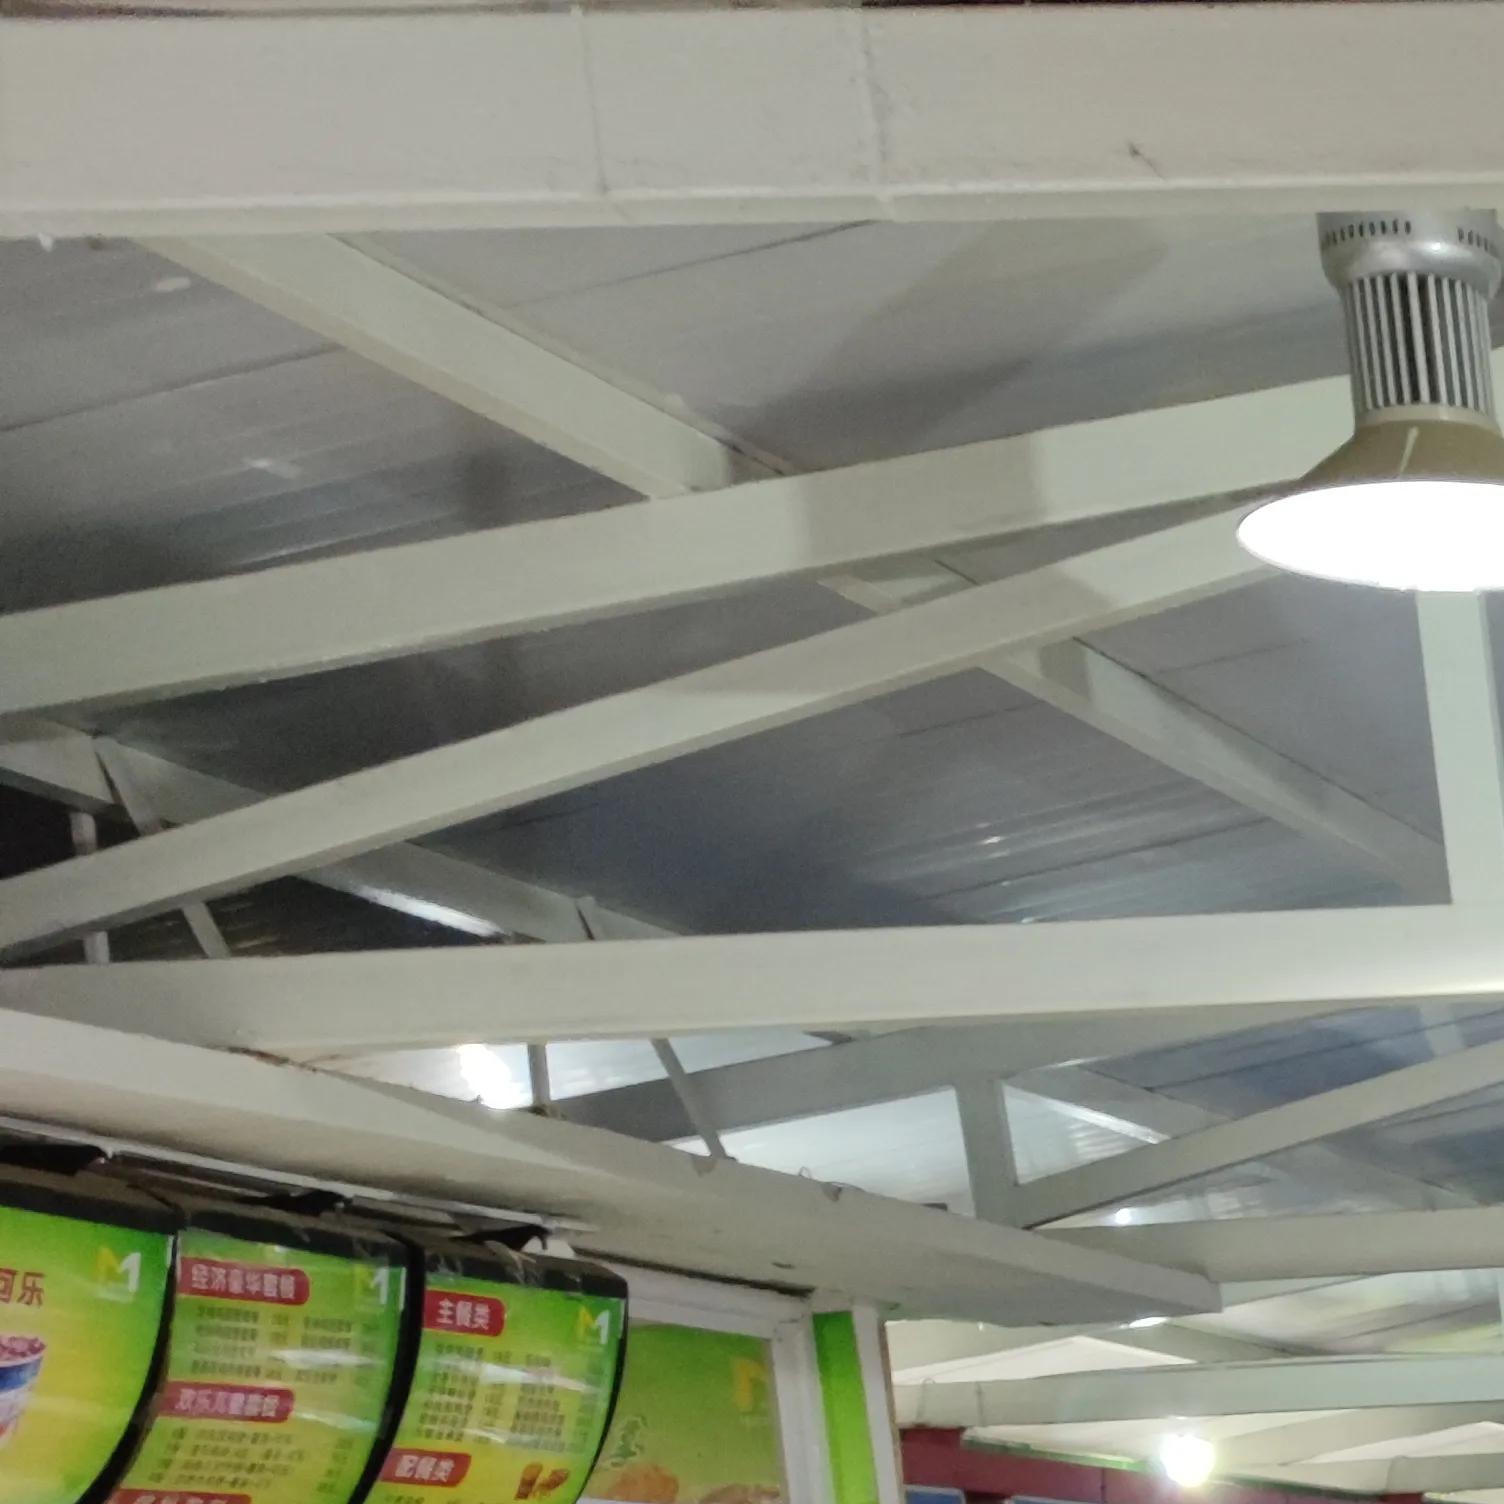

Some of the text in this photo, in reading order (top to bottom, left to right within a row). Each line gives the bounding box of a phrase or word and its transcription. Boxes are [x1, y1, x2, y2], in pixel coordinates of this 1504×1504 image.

[436, 1298, 491, 1331] 主餐类
[394, 1454, 455, 1483] 配餐类
